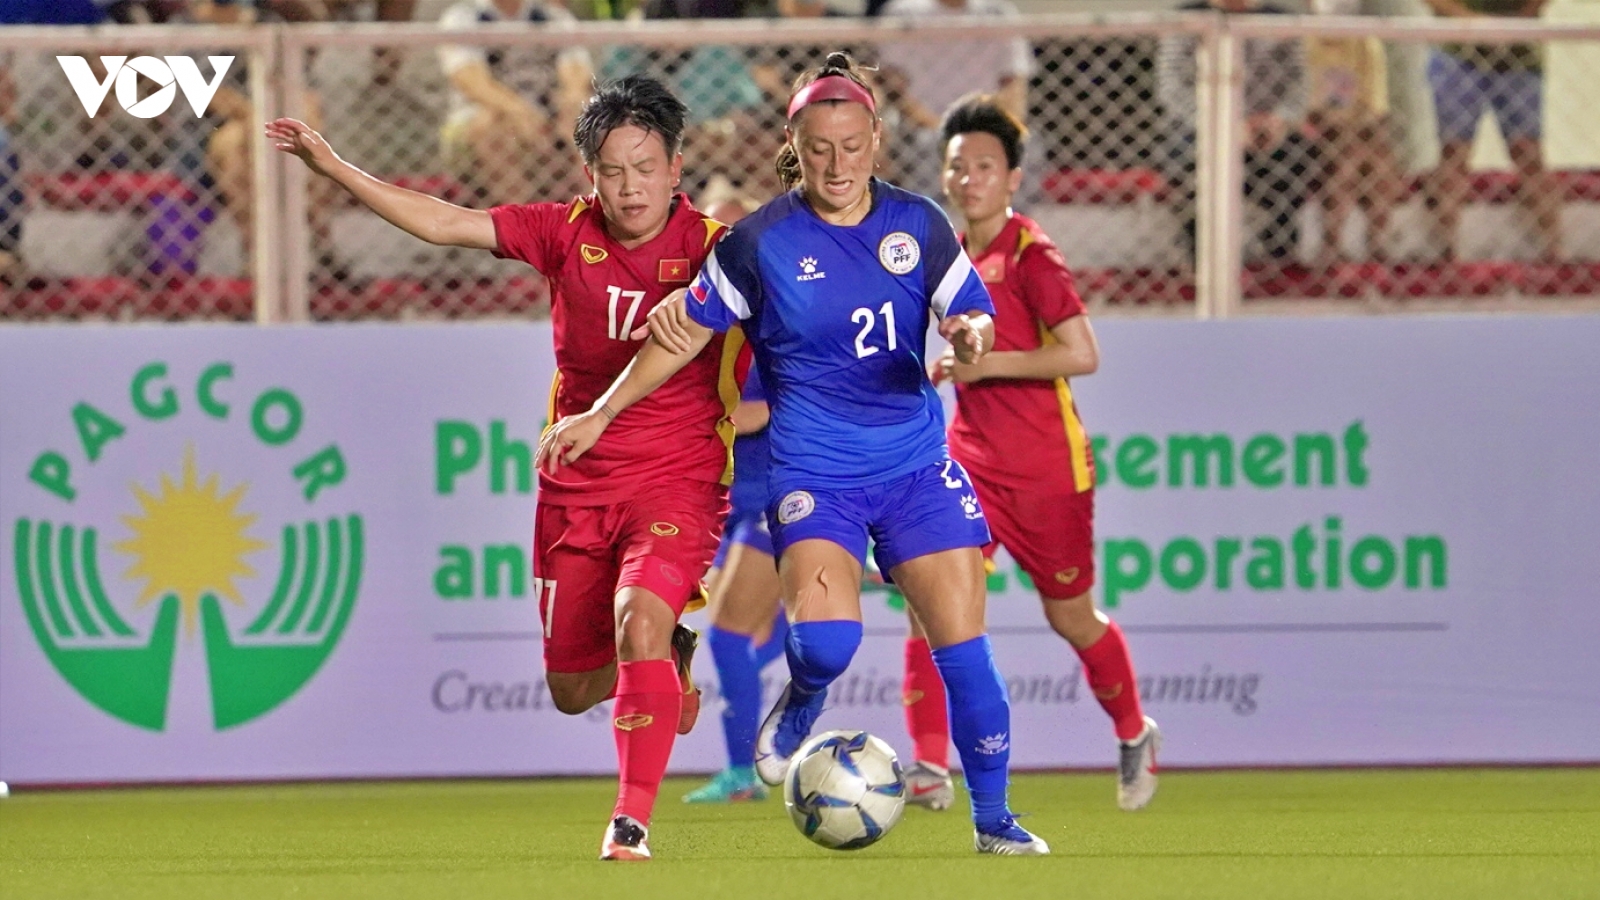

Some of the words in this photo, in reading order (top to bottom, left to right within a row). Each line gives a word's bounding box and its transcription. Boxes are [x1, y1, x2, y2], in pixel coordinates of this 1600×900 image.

[796, 271, 826, 281] KELME
[893, 254, 911, 264] PFF
[606, 285, 646, 341] 17
[851, 301, 897, 359] 21
[28, 362, 348, 502] PAGCOR
[1089, 419, 1369, 489] sement
